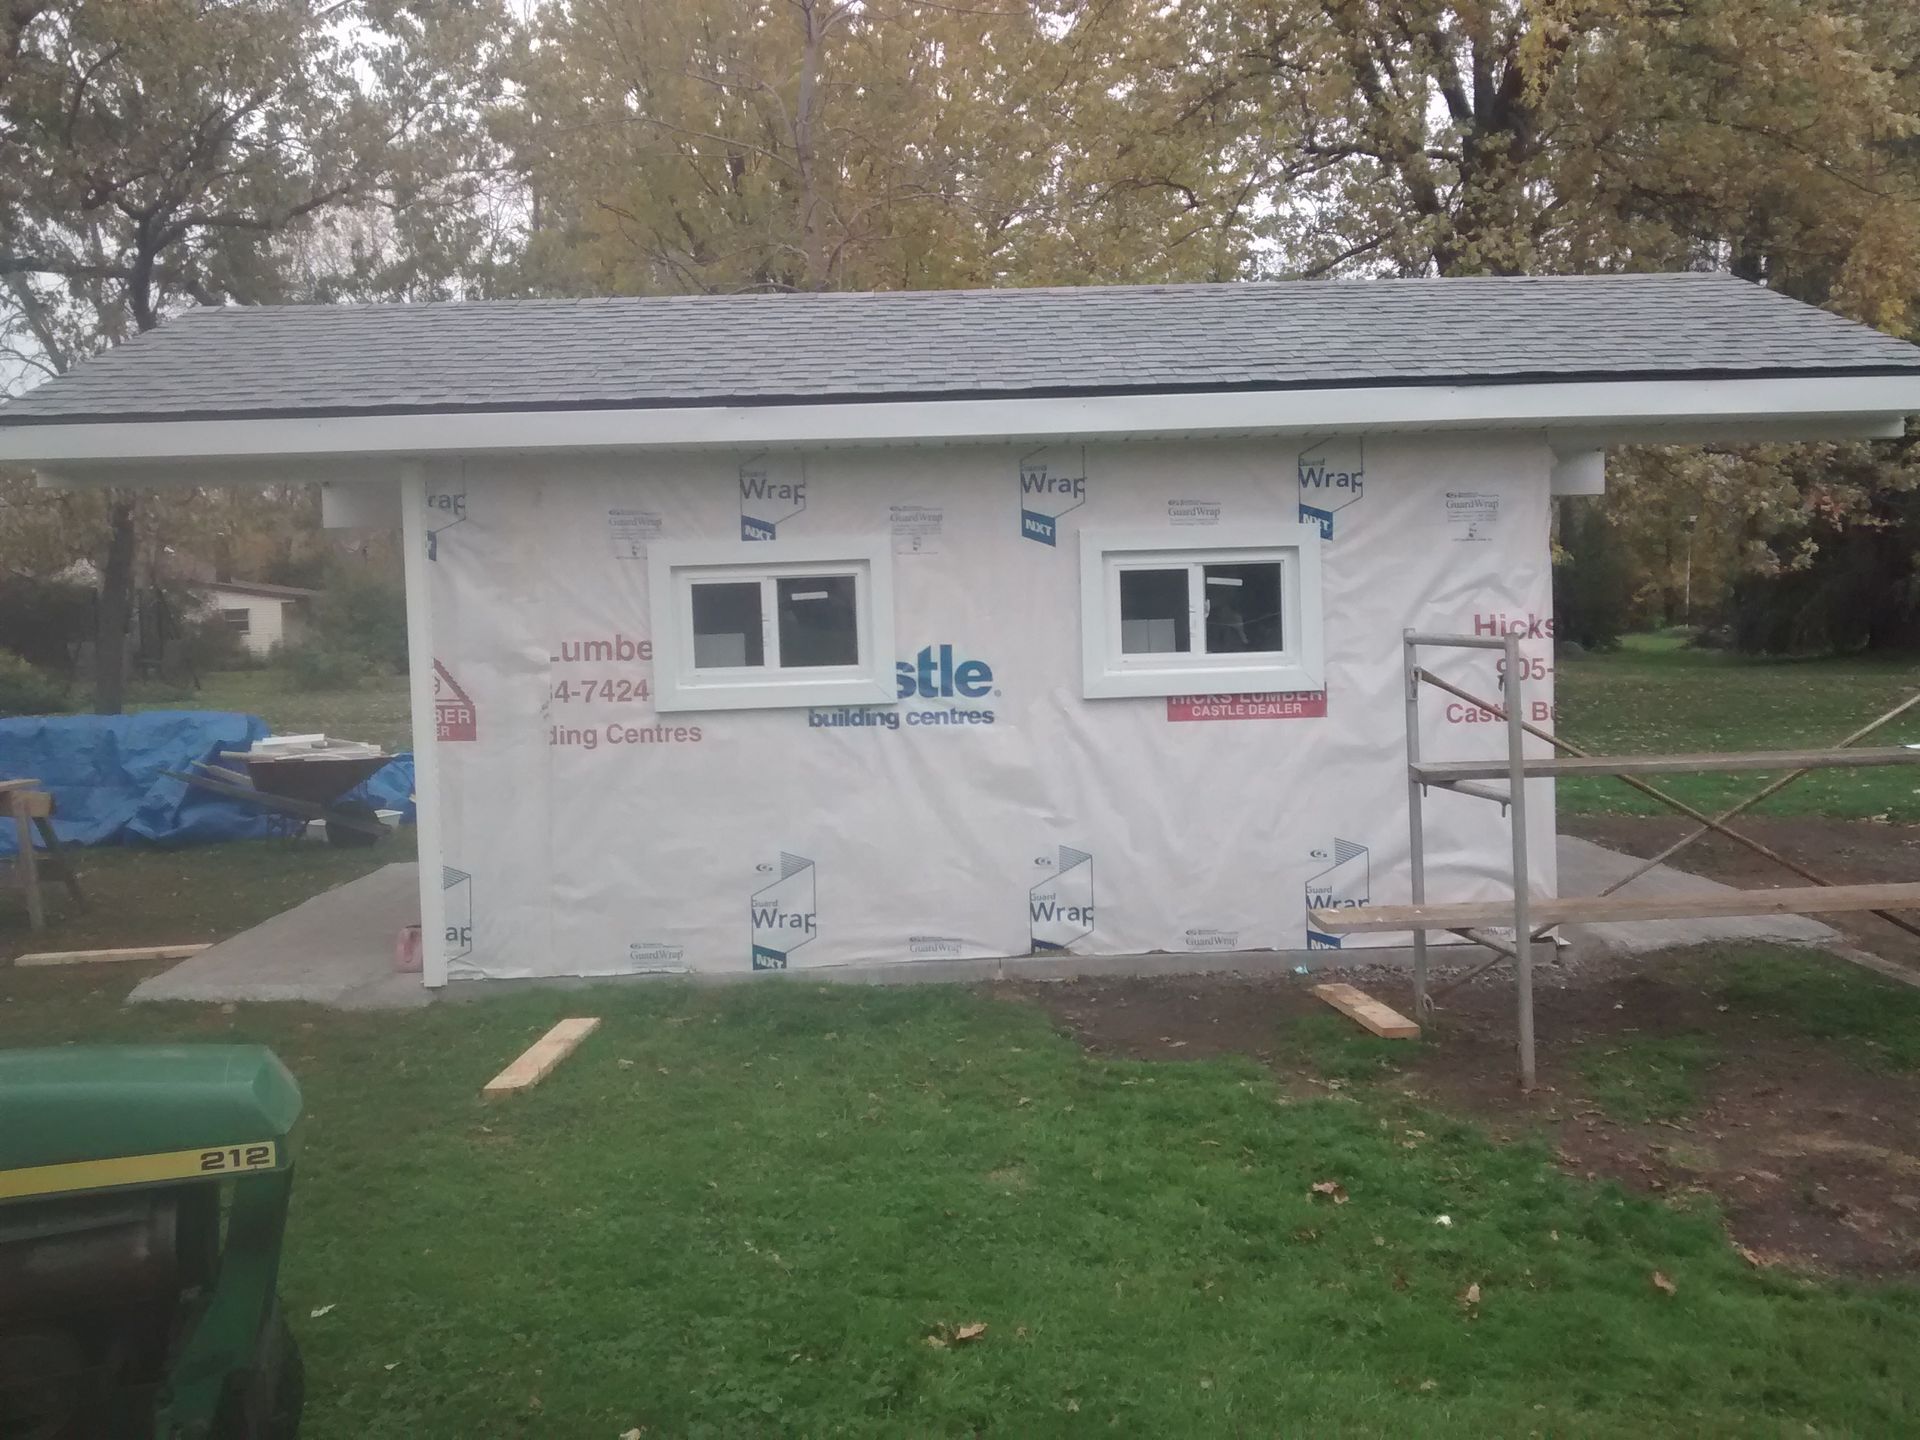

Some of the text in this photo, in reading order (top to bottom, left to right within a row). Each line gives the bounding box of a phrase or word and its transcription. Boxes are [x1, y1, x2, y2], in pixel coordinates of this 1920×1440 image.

[740, 479, 806, 505] Wrap
[1020, 472, 1086, 498] Wrap
[1298, 467, 1364, 493] Wrap
[1025, 519, 1052, 536] NXT
[1474, 613, 1554, 640] Hicks
[550, 634, 653, 662] umbe
[896, 644, 993, 699] stle
[808, 707, 995, 730] building centres
[1192, 703, 1302, 717] CASTLE DEALER
[606, 723, 702, 745] Centres
[751, 908, 817, 934] Wrap
[1030, 901, 1094, 927] Wrap
[756, 953, 784, 969] NXT
[200, 1146, 270, 1171] 212
